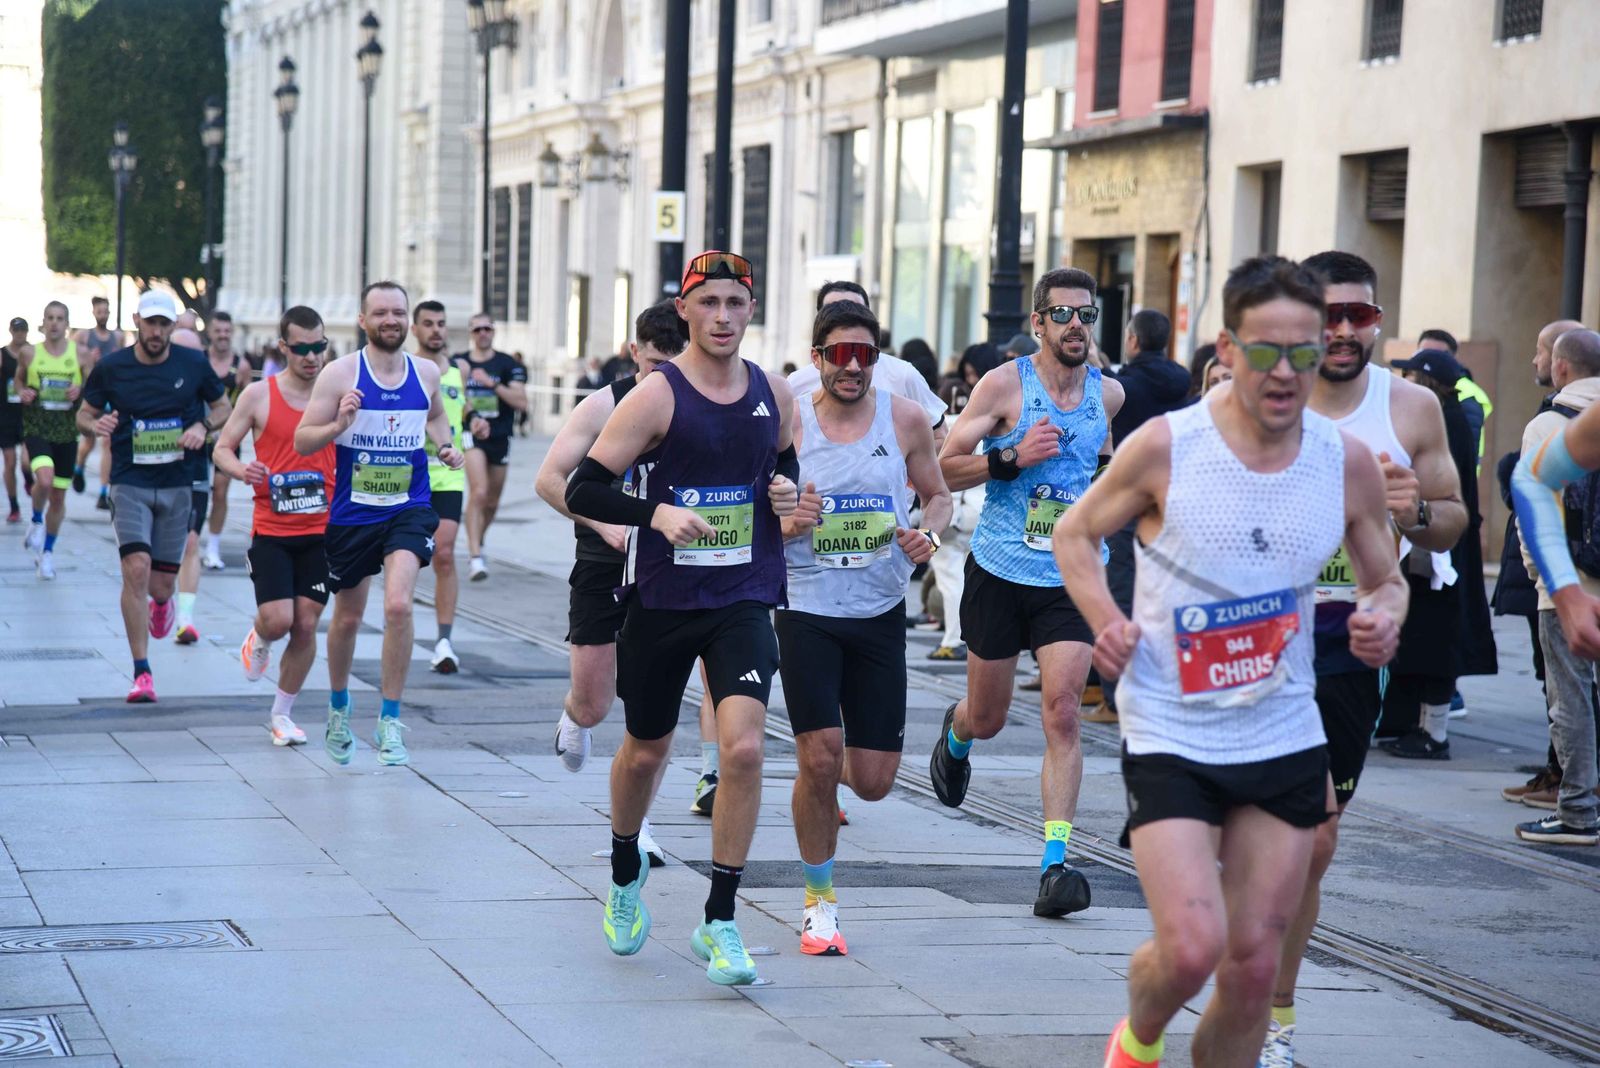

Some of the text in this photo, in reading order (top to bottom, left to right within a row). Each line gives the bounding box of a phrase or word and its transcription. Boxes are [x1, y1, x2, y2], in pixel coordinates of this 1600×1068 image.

[662, 204, 675, 229] 5
[352, 434, 374, 448] FINN
[376, 435, 409, 448] VALLEY
[374, 456, 407, 464] ZURICH
[287, 473, 319, 482] ZURICH
[374, 471, 391, 480] 3311
[363, 481, 401, 493] SHAUN
[278, 496, 323, 512] ANTOINE
[705, 490, 748, 503] ZURICH
[841, 498, 885, 509] ZURICH
[707, 515, 731, 526] 3071
[843, 520, 867, 531] 3182
[1026, 520, 1054, 536] JAVI
[697, 530, 738, 547] HUGO
[814, 536, 861, 553] JOANA
[1316, 561, 1351, 582] AÚL
[1215, 597, 1282, 623] ZURICH
[1226, 636, 1254, 655] 944
[1208, 653, 1275, 687] CHRIS
